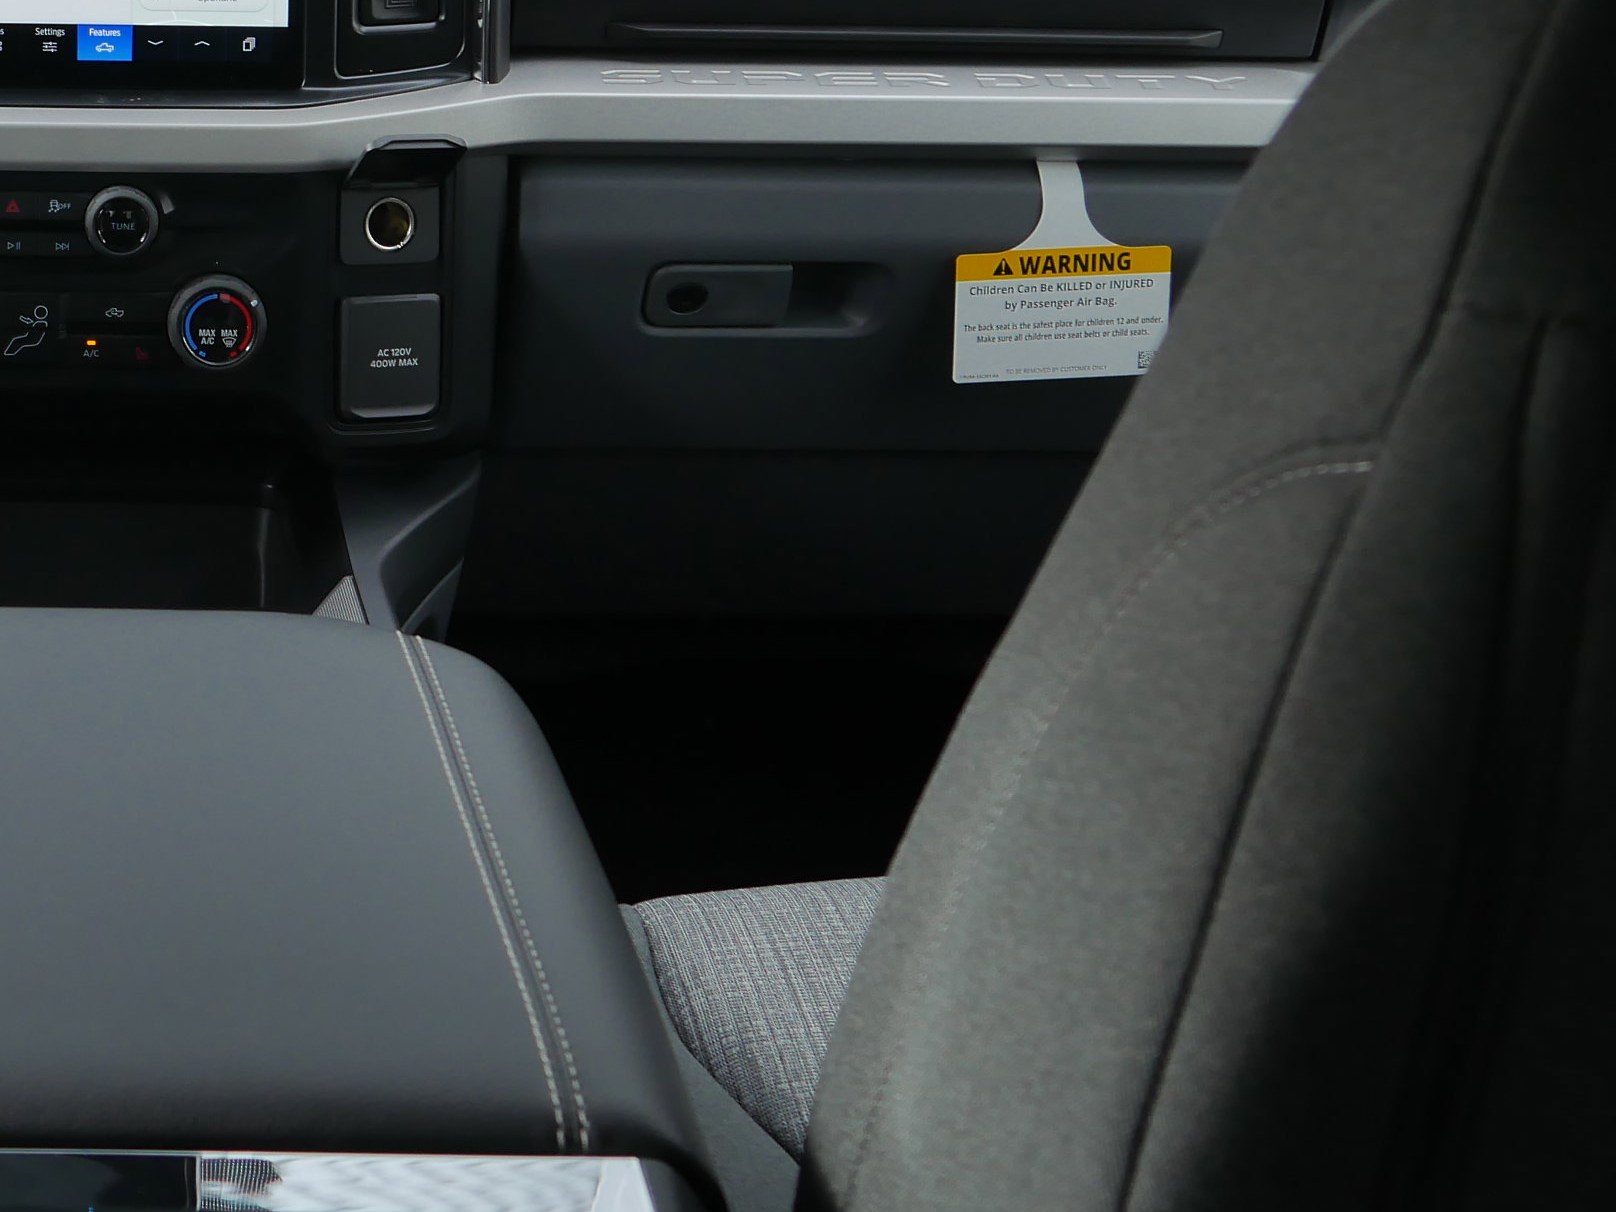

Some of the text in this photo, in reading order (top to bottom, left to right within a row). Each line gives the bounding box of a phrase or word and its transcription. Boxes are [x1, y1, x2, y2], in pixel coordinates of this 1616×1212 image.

[35, 27, 66, 37] Settings
[89, 28, 121, 37] Features
[601, 69, 1247, 90] SUPER DUTY
[111, 223, 135, 231] TUNE
[1019, 252, 1131, 275] WARNING
[969, 278, 1154, 296] Children Can Be KILLED or INJURED
[1005, 295, 1118, 311] by Passenger Air Bag.
[964, 324, 976, 332] The
[978, 323, 994, 331] back
[1012, 322, 1018, 330] is
[1019, 321, 1031, 329] the
[1032, 320, 1053, 329] safest
[1055, 319, 1073, 328] place
[1075, 318, 1085, 327] for
[1086, 317, 1115, 327] children
[1117, 317, 1125, 325] 12
[1126, 316, 1140, 324] and
[1141, 316, 1164, 324] under.
[198, 329, 216, 337] MAX
[221, 329, 238, 338] MAX
[976, 335, 996, 343] Make
[1014, 333, 1023, 342] all
[1024, 332, 1053, 341] children
[1054, 332, 1066, 340] use
[1068, 331, 1083, 339] seat
[1084, 330, 1101, 338] belts
[1111, 329, 1128, 337] child
[201, 337, 215, 346] A/C
[83, 349, 100, 358] A/C
[377, 348, 412, 357] AC 120V
[370, 357, 419, 368] 400W MAX
